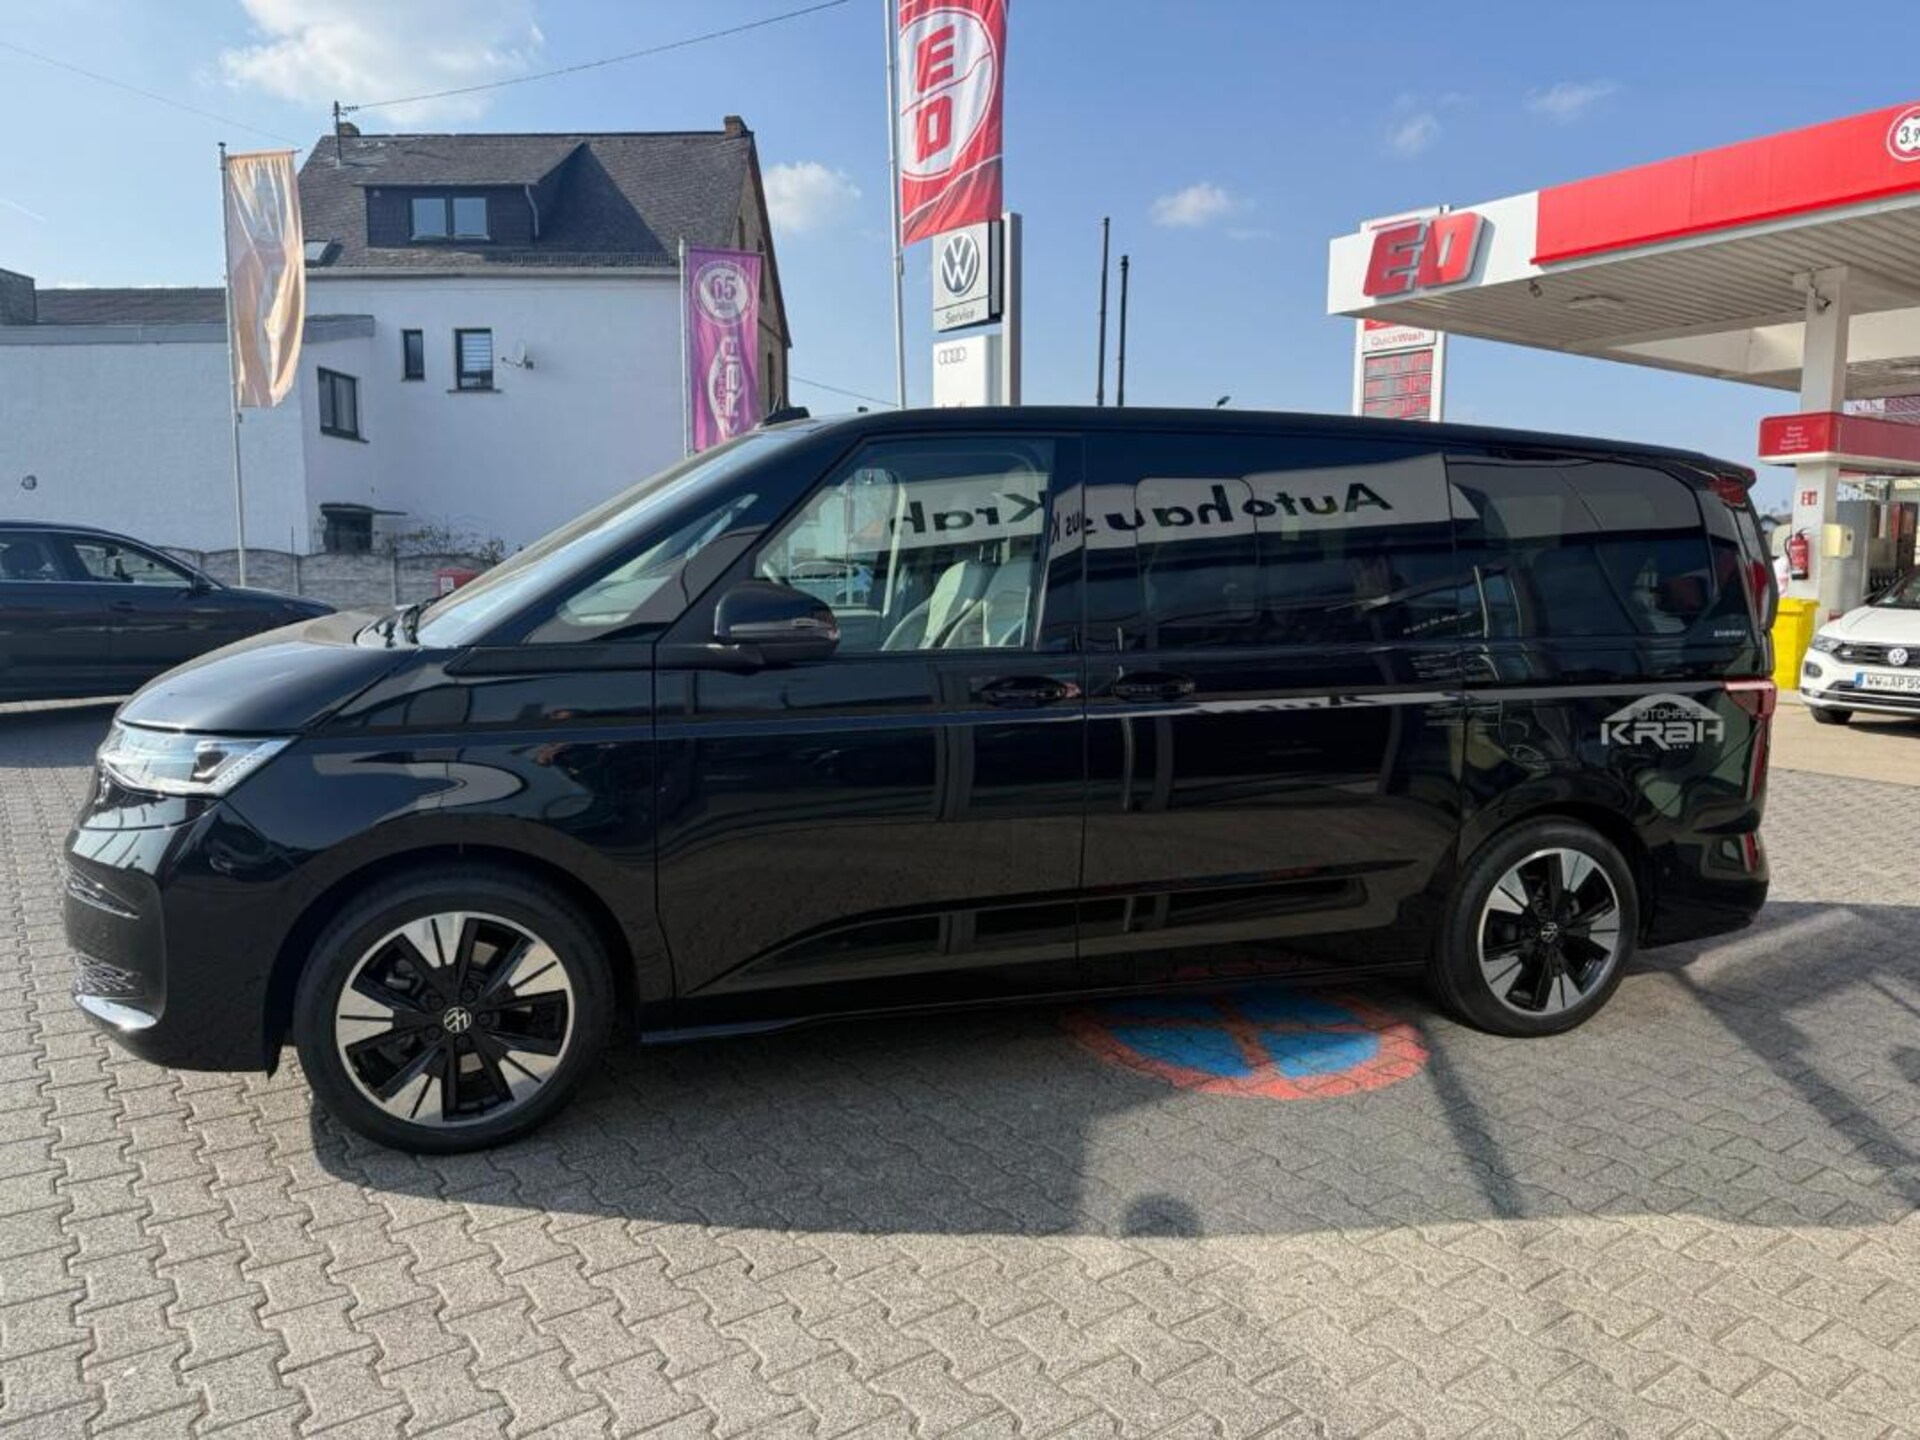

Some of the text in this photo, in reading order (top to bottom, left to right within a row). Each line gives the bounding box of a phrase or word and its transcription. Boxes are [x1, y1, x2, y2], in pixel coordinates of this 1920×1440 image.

[916, 24, 955, 164] ED
[1363, 211, 1484, 297] ED
[945, 309, 975, 325] Service
